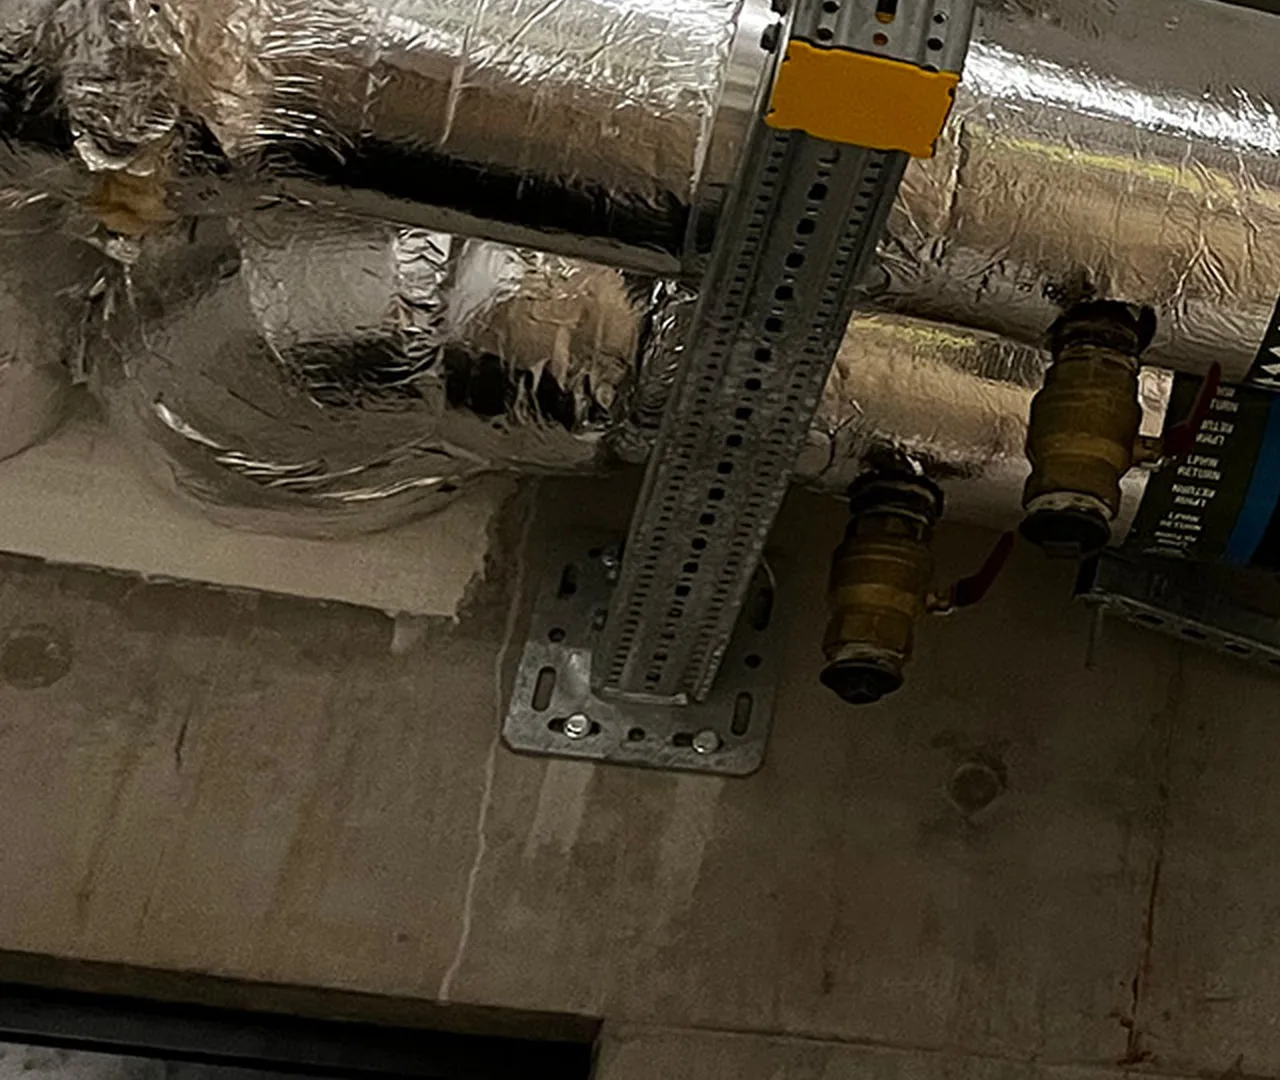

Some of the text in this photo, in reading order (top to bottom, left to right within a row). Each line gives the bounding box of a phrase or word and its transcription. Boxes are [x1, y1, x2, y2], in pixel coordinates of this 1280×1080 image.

[1187, 454, 1219, 468] LPHW
[1177, 465, 1221, 480] RETURN
[1172, 484, 1216, 499] RETURN
